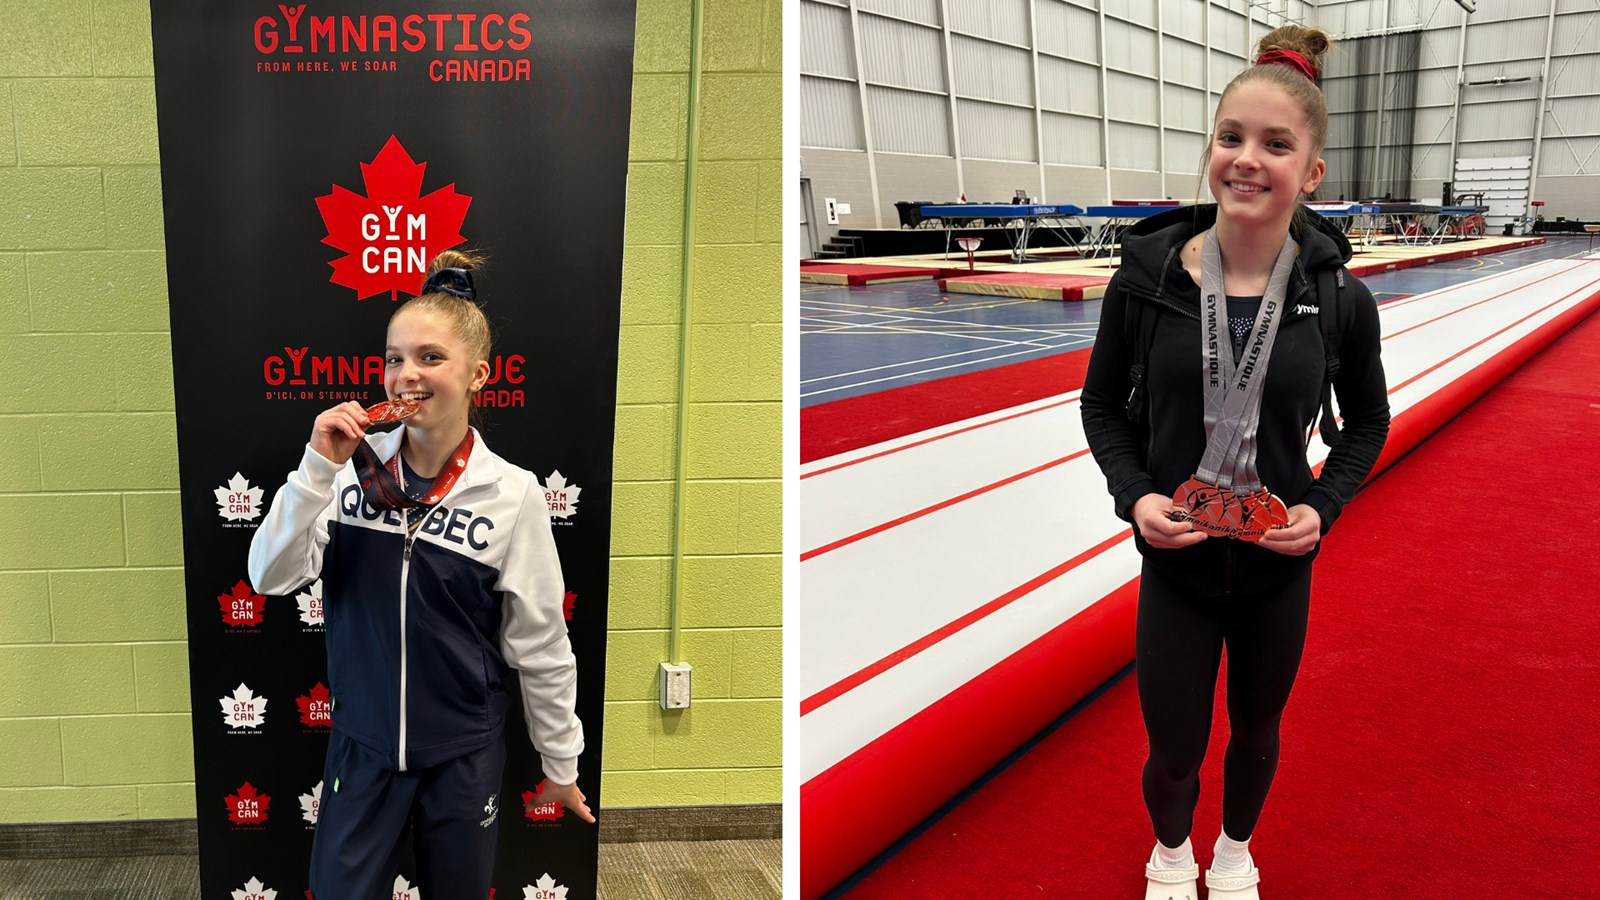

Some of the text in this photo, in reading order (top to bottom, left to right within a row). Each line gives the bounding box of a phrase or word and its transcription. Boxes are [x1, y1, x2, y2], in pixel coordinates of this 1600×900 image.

[254, 4, 532, 54] GYMNASTICS
[257, 60, 398, 73] FROM HERE, WE SOAR
[429, 58, 531, 82] CANADA
[361, 205, 426, 241] GYM
[361, 246, 426, 274] CAN
[1207, 294, 1219, 388] GYMNASTIQUE
[1236, 301, 1277, 392] GYMNASTIQUE
[266, 391, 369, 400] D'ICI, ON S'ENVOLE
[473, 389, 525, 407] NADA
[228, 492, 250, 503] GYM
[545, 490, 567, 501] GYM
[229, 504, 251, 513] CAN
[231, 599, 253, 610] GYM
[310, 598, 322, 609] GY
[232, 611, 253, 619] CAN
[310, 610, 324, 618] CA
[233, 701, 254, 712] GYM
[309, 700, 330, 711] GYM
[234, 713, 254, 721] CAN
[309, 712, 330, 720] CAN
[237, 799, 258, 809] GYM
[238, 810, 258, 818] CAN
[534, 806, 555, 815] CAN
[535, 890, 556, 899] GYM
